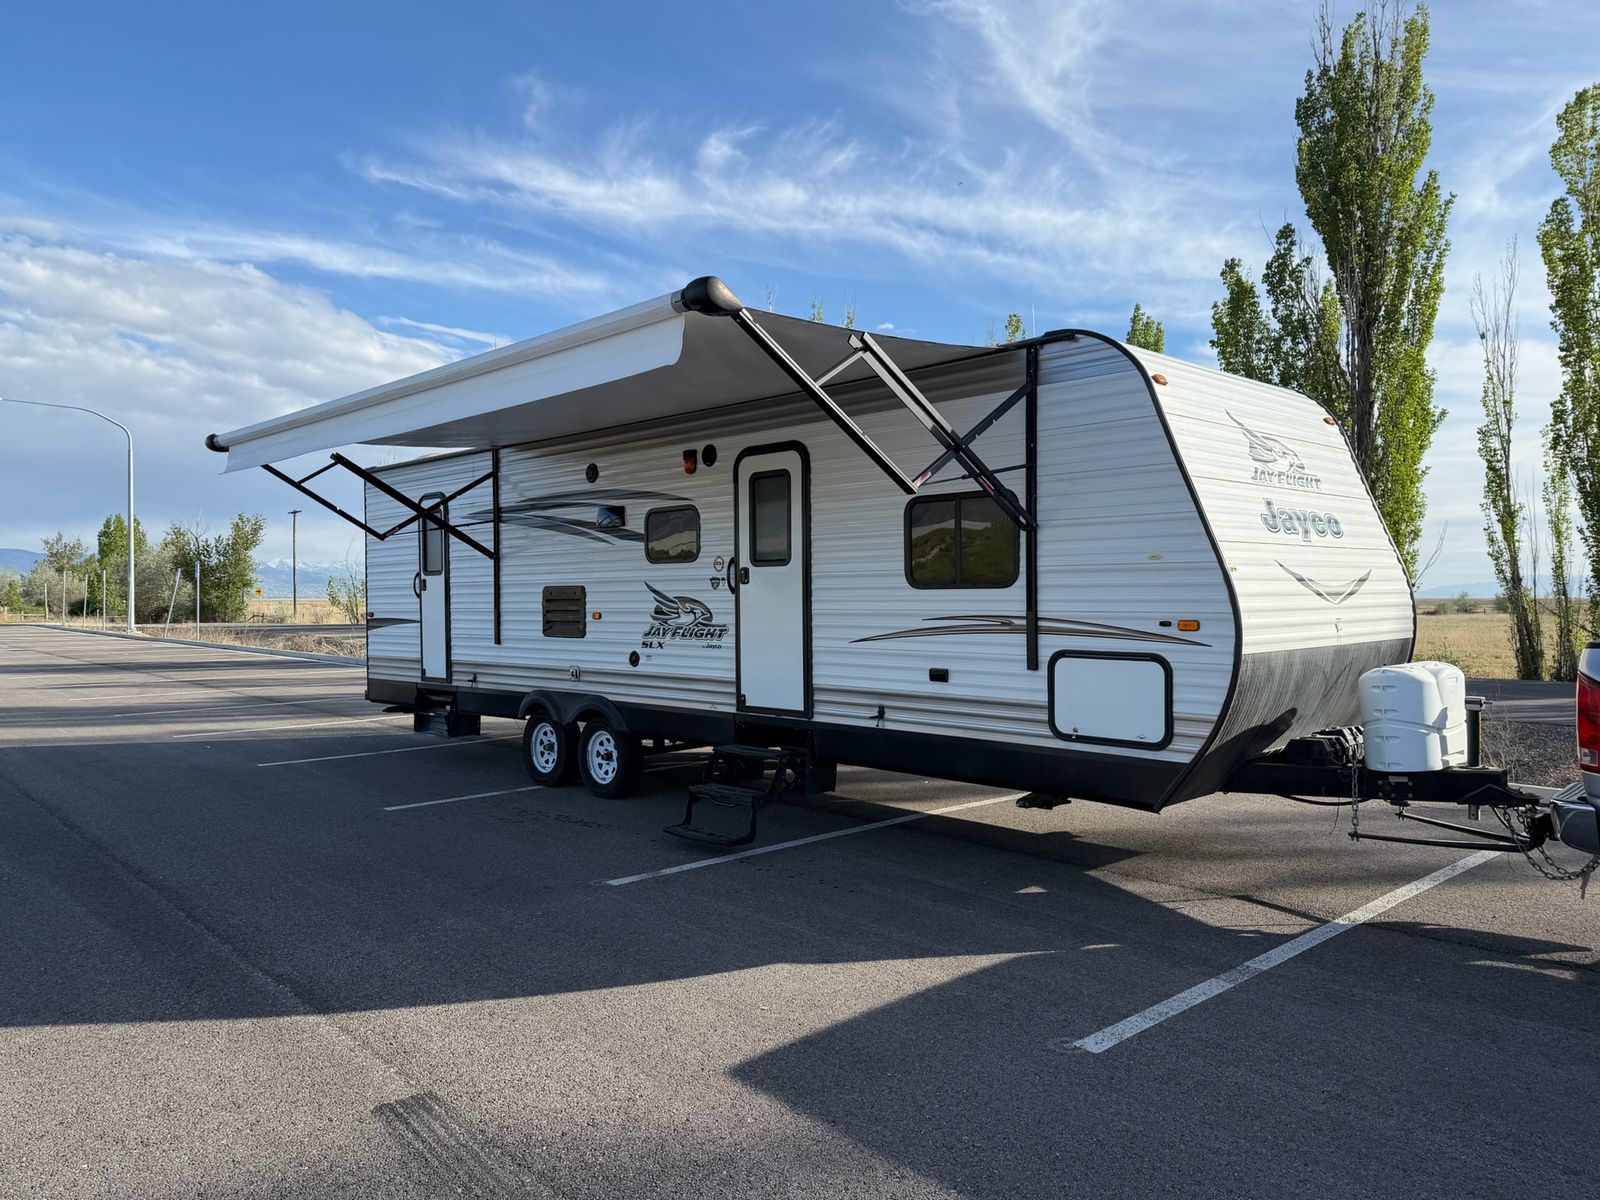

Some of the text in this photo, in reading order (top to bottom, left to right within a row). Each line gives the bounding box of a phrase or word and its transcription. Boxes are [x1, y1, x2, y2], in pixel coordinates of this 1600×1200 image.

[1251, 467, 1321, 490] JAY FLIGHT
[1260, 497, 1344, 542] Jayco
[643, 624, 729, 641] JAY FLIGHT
[641, 641, 665, 649] SLX
